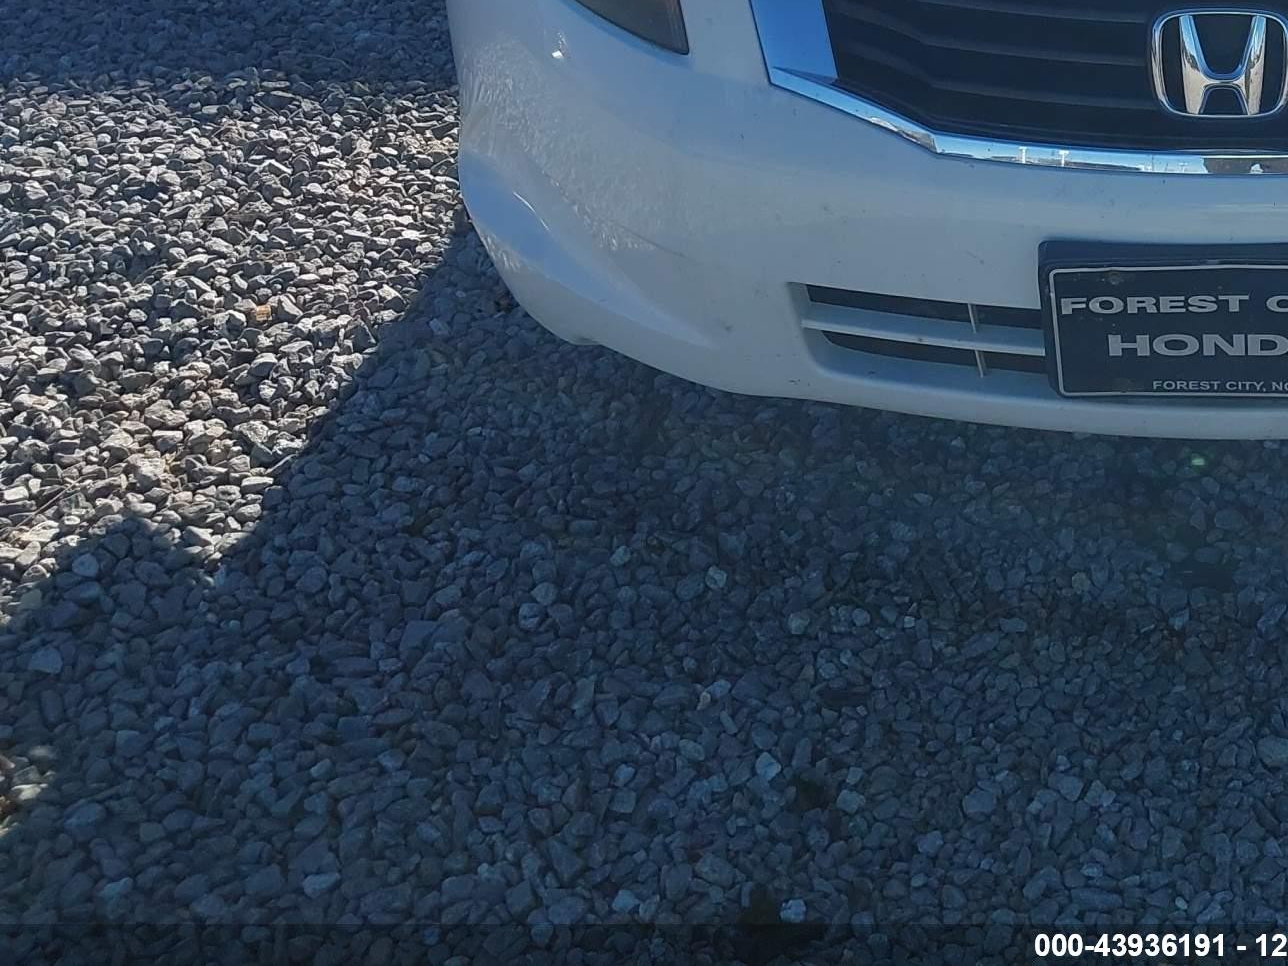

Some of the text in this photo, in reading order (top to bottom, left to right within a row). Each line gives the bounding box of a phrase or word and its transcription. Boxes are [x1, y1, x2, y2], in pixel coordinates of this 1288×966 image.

[1060, 294, 1250, 315] FOREST
[1152, 379, 1222, 391] FOREST
[1225, 380, 1267, 393] CITY,
